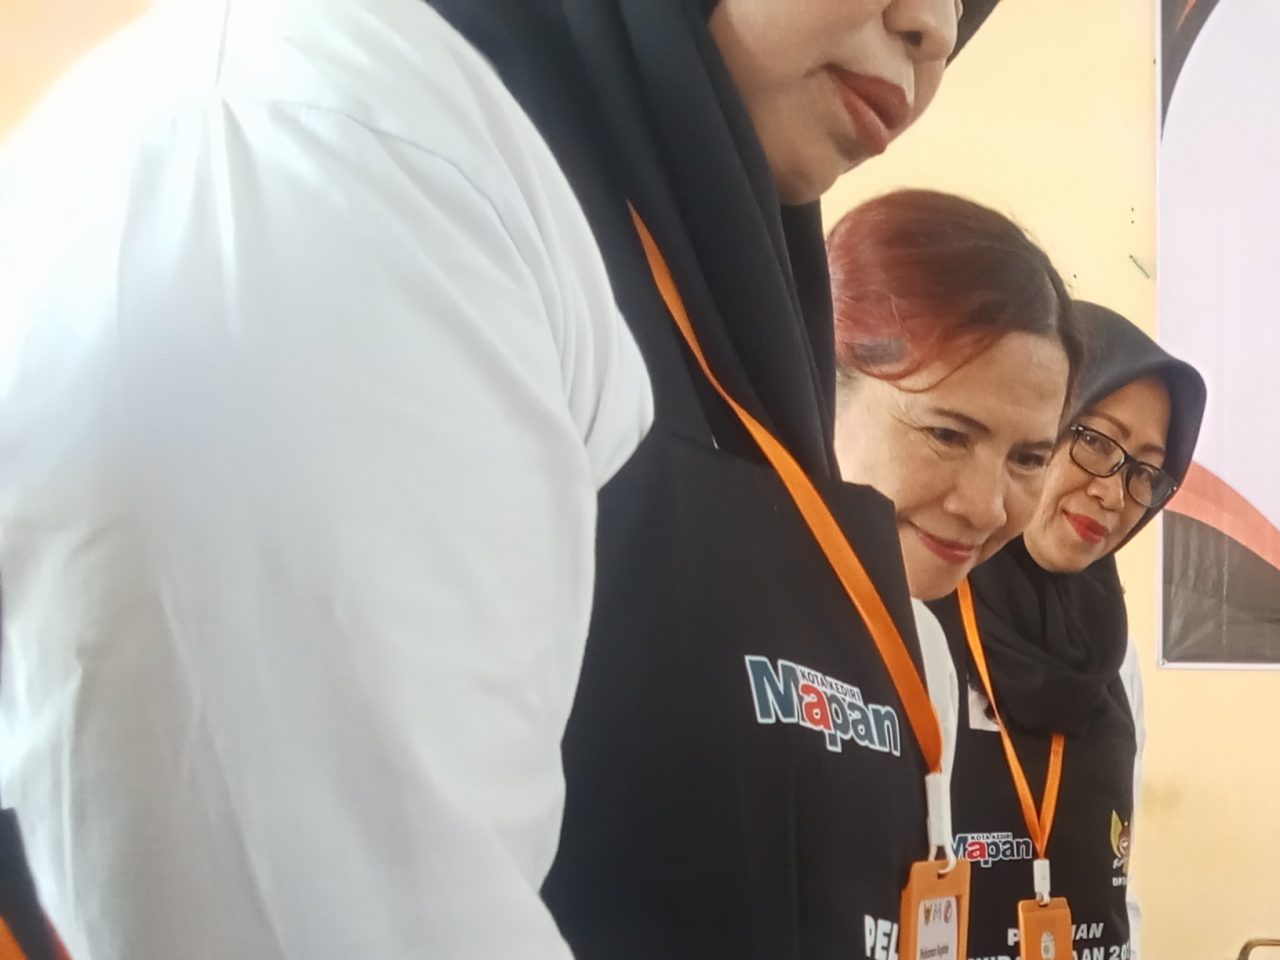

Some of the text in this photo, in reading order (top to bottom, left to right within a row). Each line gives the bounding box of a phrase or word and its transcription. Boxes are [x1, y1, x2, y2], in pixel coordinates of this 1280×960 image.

[744, 655, 901, 758] Mapan
[800, 669, 863, 702] KOTA KEDIRI
